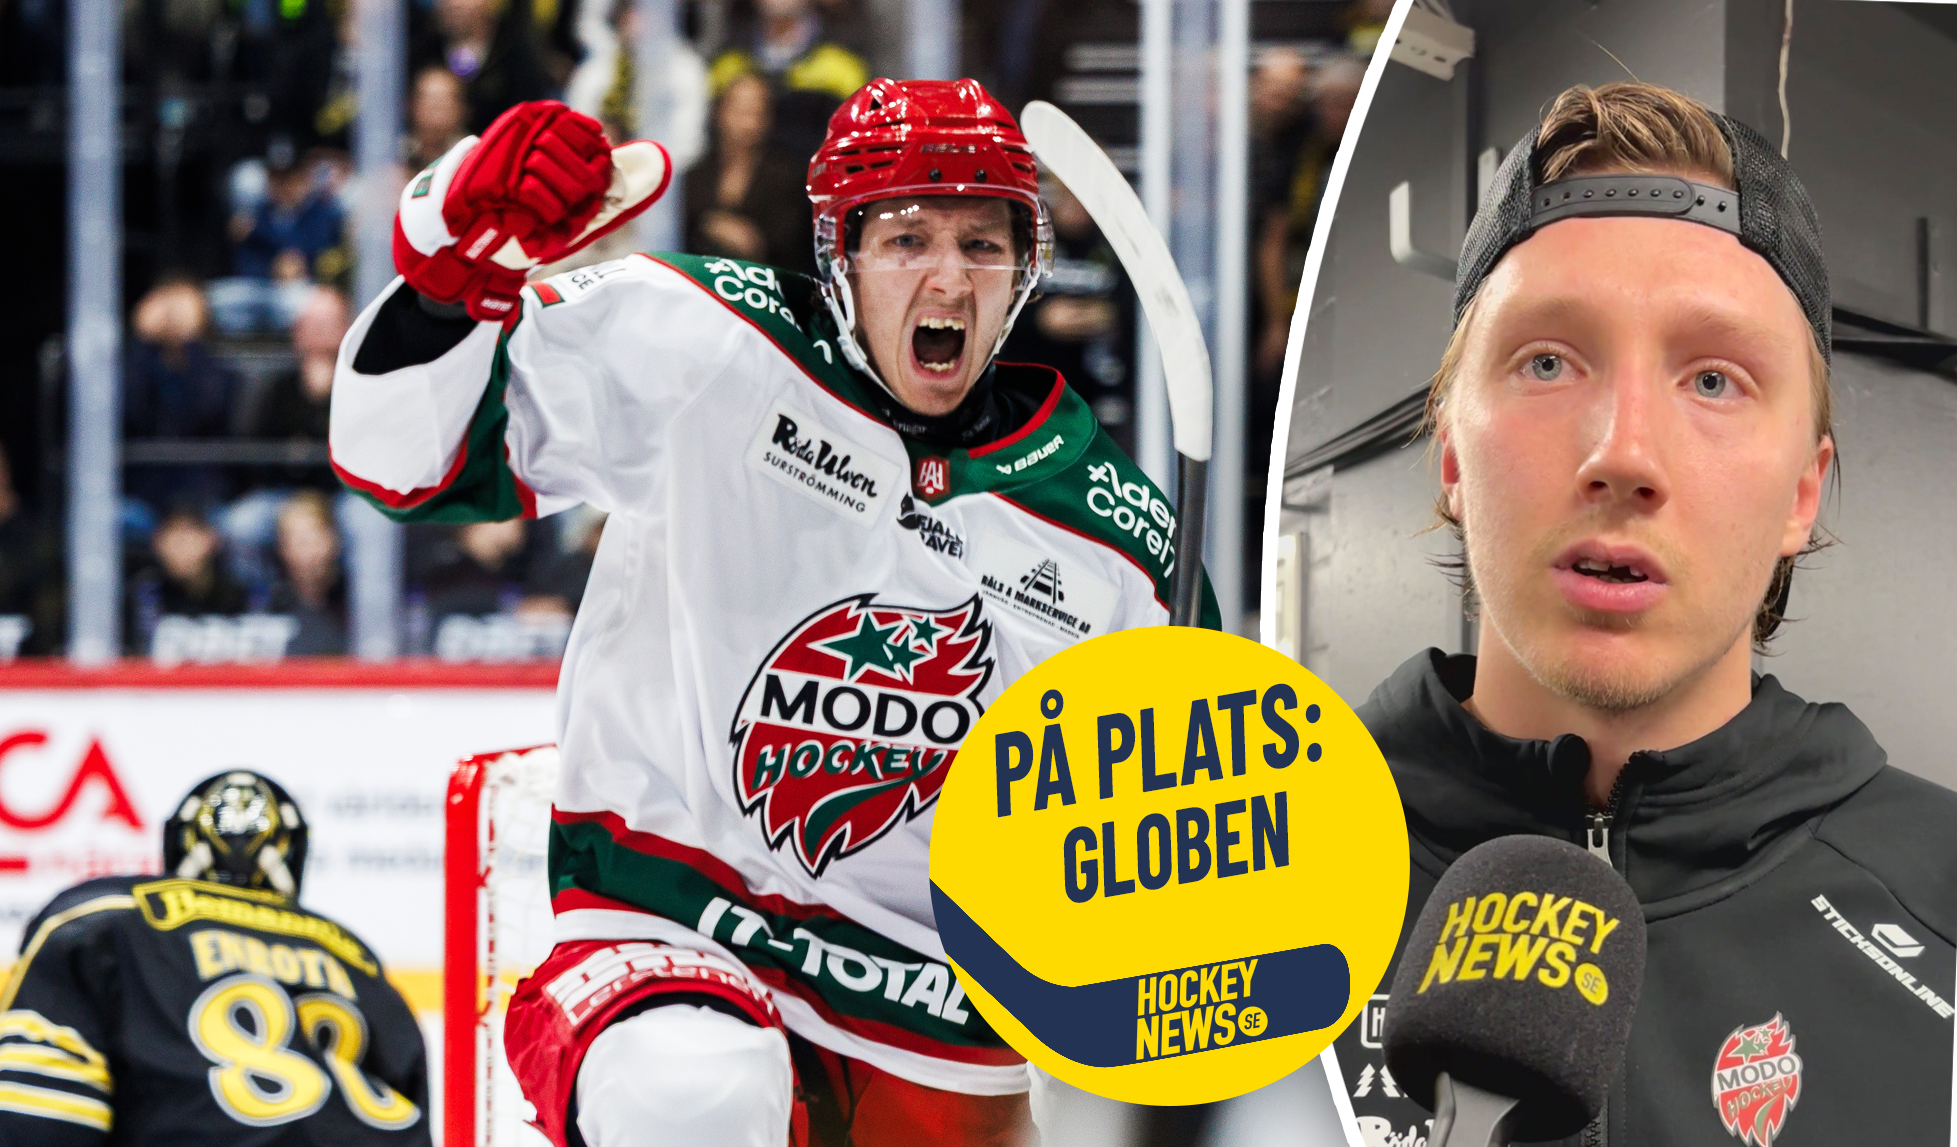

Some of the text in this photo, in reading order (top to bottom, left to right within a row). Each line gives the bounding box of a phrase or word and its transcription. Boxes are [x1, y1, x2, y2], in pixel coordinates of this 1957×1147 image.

[763, 451, 866, 512] SURSTRÖMMING
[1014, 434, 1065, 472] BAUER
[1014, 590, 1078, 629] MARKSERVICE
[759, 674, 972, 744] MODO
[752, 741, 944, 791] HOCKEY
[1439, 891, 1620, 954] HOCKEY
[698, 897, 969, 1026] IT-TOTAL
[1417, 933, 1602, 995] NEWS SE
[1811, 894, 1956, 1019] STICKSONLINE
[1716, 1056, 1796, 1091] MODO
[1726, 1075, 1793, 1120] HOCKEY
